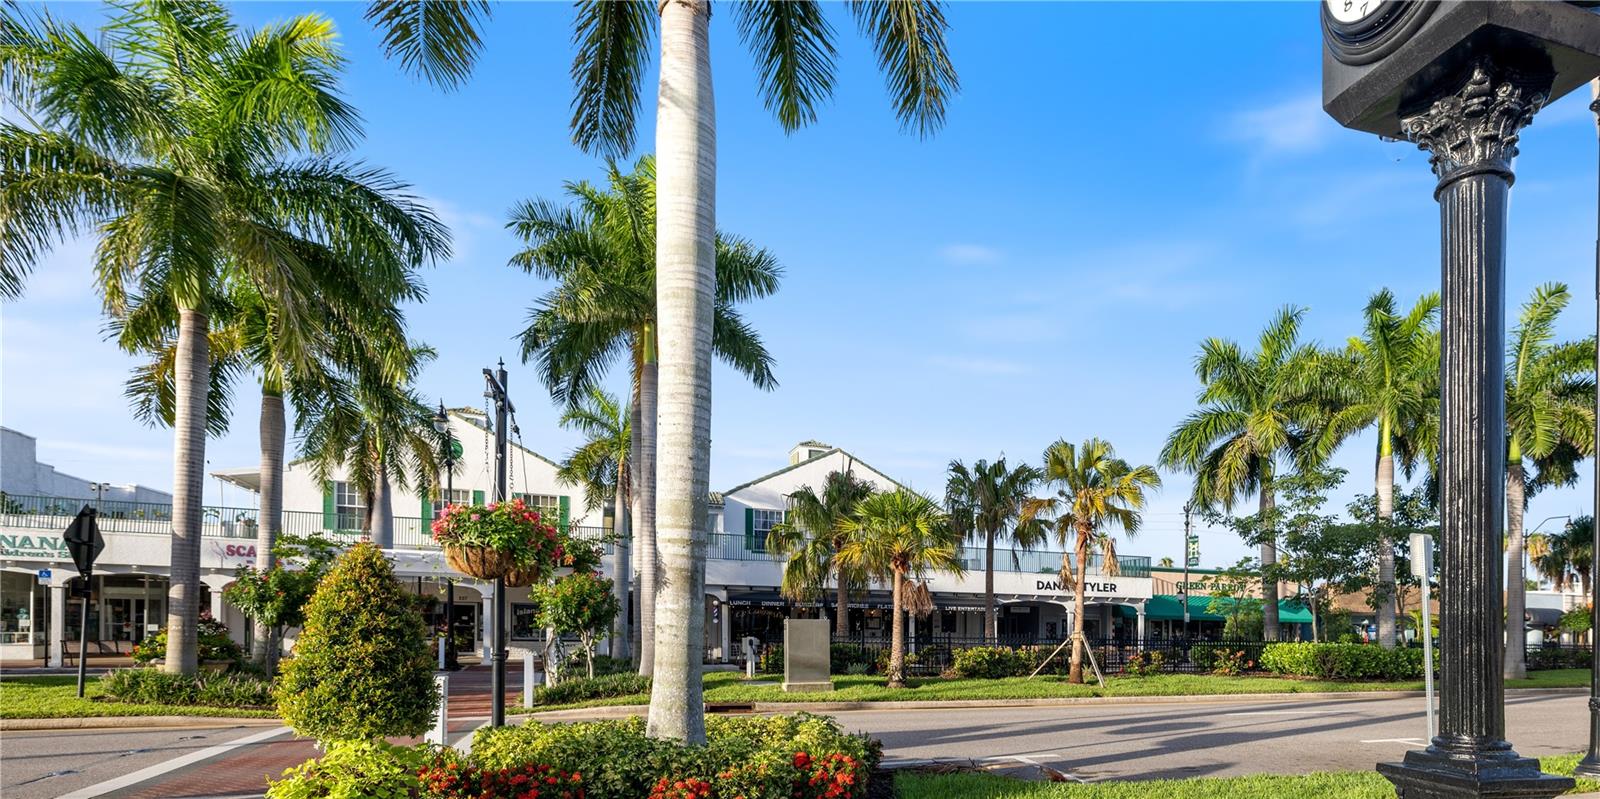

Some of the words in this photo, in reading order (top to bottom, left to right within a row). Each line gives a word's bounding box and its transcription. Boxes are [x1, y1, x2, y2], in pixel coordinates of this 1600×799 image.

[1360, 1, 1369, 16] 7
[1037, 580, 1070, 592] DANA
[1084, 582, 1117, 593] TYLER
